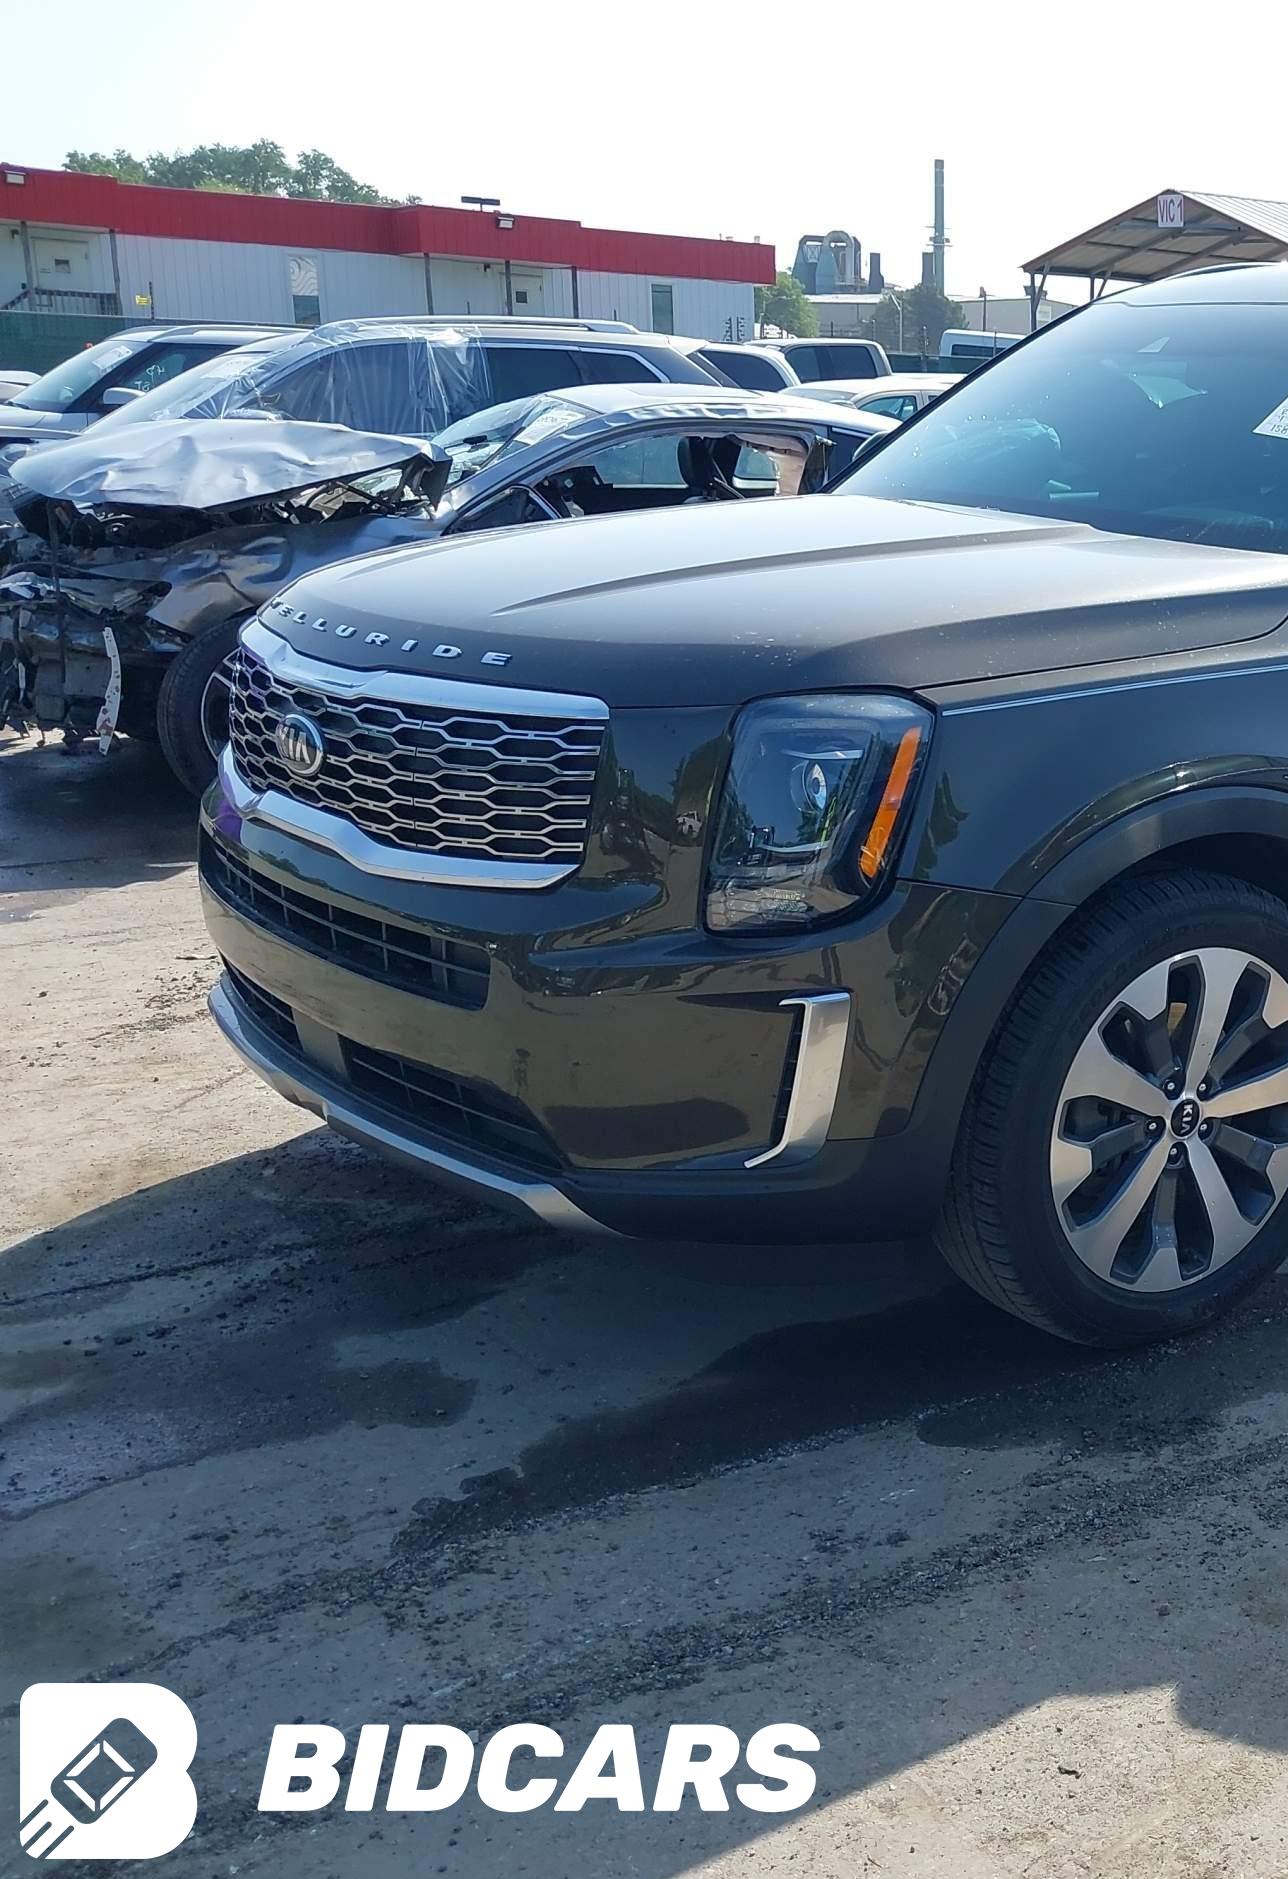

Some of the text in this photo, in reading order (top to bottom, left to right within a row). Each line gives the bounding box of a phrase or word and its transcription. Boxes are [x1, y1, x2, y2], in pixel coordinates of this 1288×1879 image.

[1158, 199, 1175, 223] VIC
[279, 724, 311, 764] KIA
[1181, 1104, 1194, 1134] KIA
